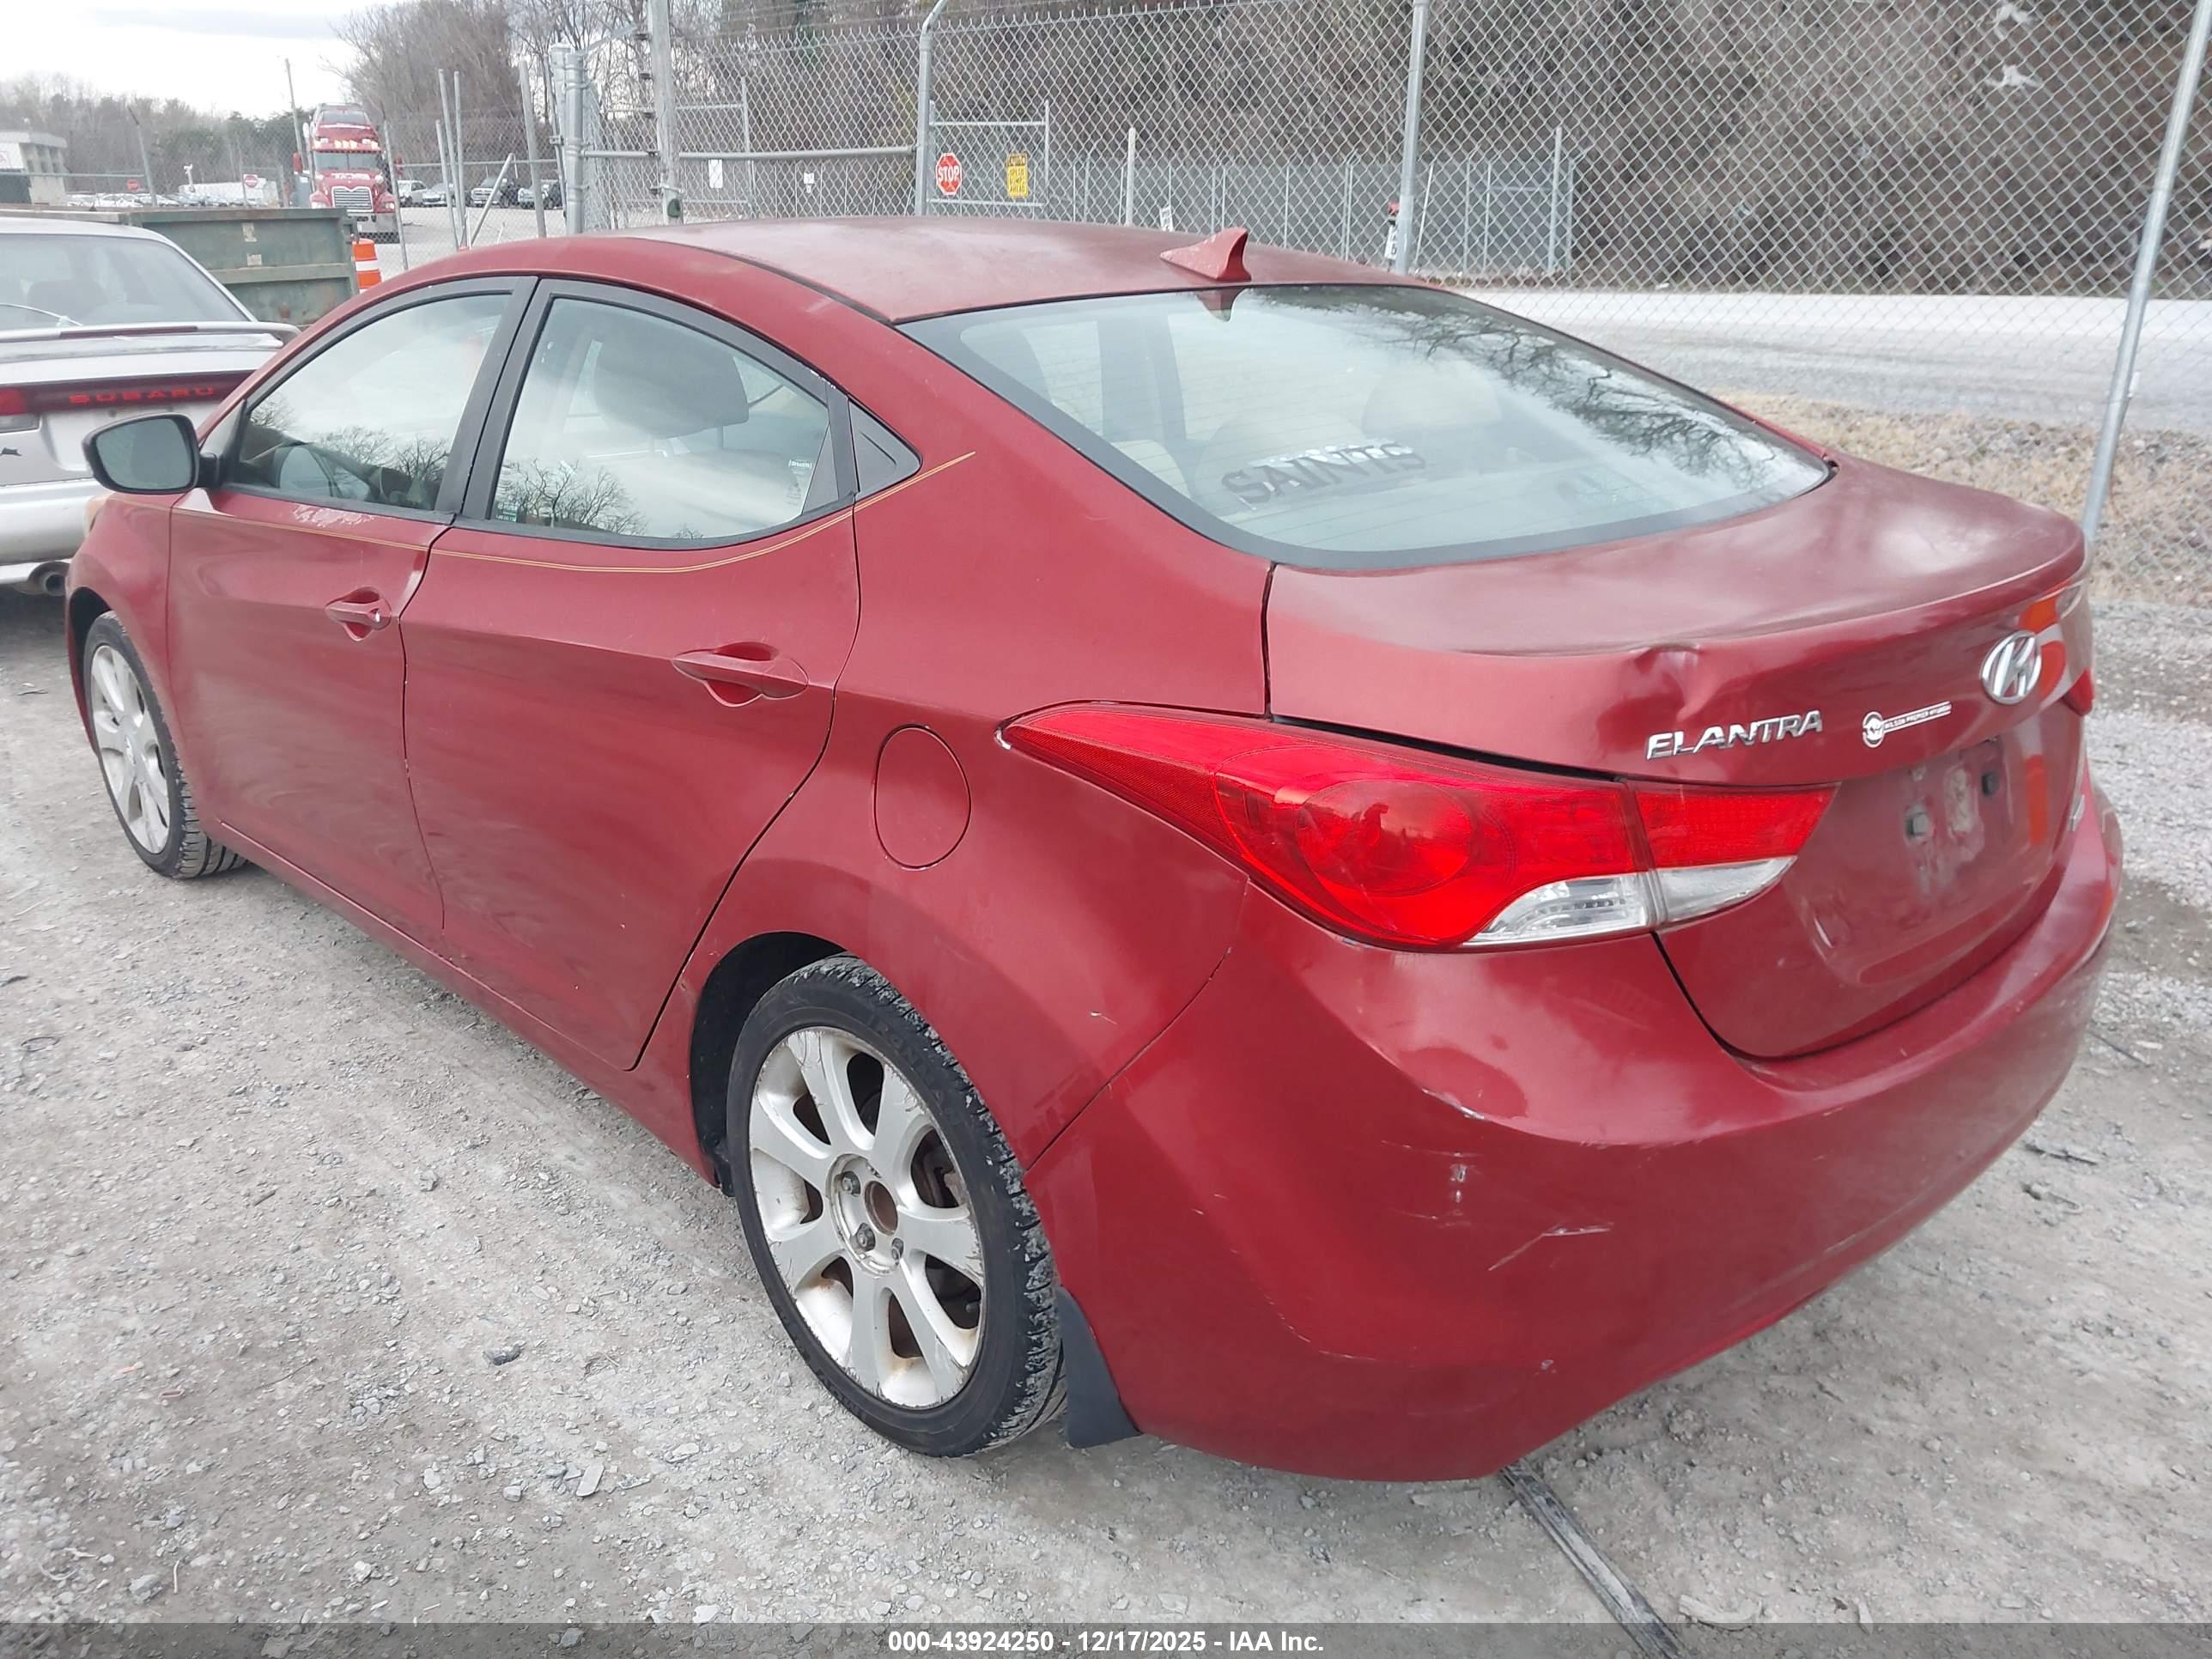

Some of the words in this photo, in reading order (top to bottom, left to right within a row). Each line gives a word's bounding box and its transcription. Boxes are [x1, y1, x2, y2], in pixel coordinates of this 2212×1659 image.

[939, 165, 959, 182] STOP
[69, 386, 214, 404] SUBARU
[1222, 441, 1425, 504] SAINTS
[1647, 710, 1823, 760] ELANTRA
